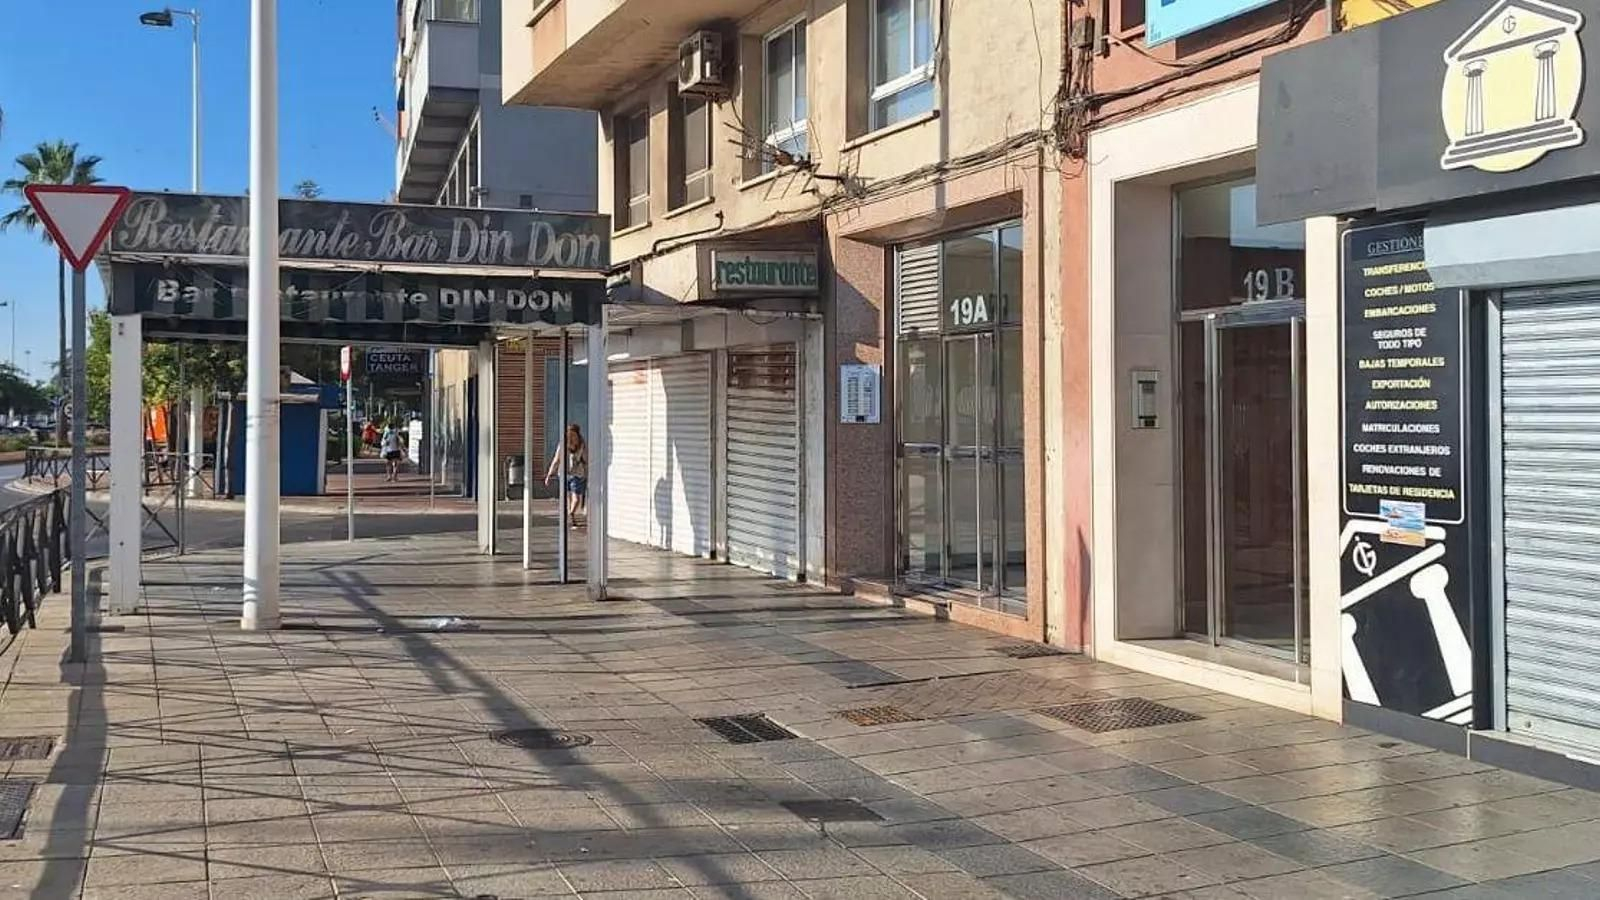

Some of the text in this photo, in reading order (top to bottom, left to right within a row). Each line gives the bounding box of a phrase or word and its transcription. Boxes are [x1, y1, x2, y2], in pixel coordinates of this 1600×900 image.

[119, 196, 600, 266] Restaante Bar Din Don
[717, 256, 816, 285] restaurante
[1243, 268, 1295, 302] 19 B
[1364, 285, 1398, 298] COCHES
[1404, 282, 1436, 294] MOTOS
[950, 295, 988, 325] 19A
[1364, 303, 1437, 318] EMBARCACIONES
[1372, 327, 1427, 339] SEGUROS DE
[1378, 338, 1422, 350] TODO TIPO
[370, 353, 412, 362] CEUTA
[1358, 356, 1446, 370] BAJAS TEMPORALES
[1371, 376, 1431, 390] EXPORTACIÓN
[1365, 399, 1438, 411] AUTORIZACIONES
[1362, 423, 1441, 434] MATRICULACIONES
[1353, 443, 1451, 456] COCHES EXTRANJEROS
[1361, 464, 1442, 478] RENOVACIONES DE
[1349, 482, 1456, 500] TARJETAS DE RESIDENCIA
